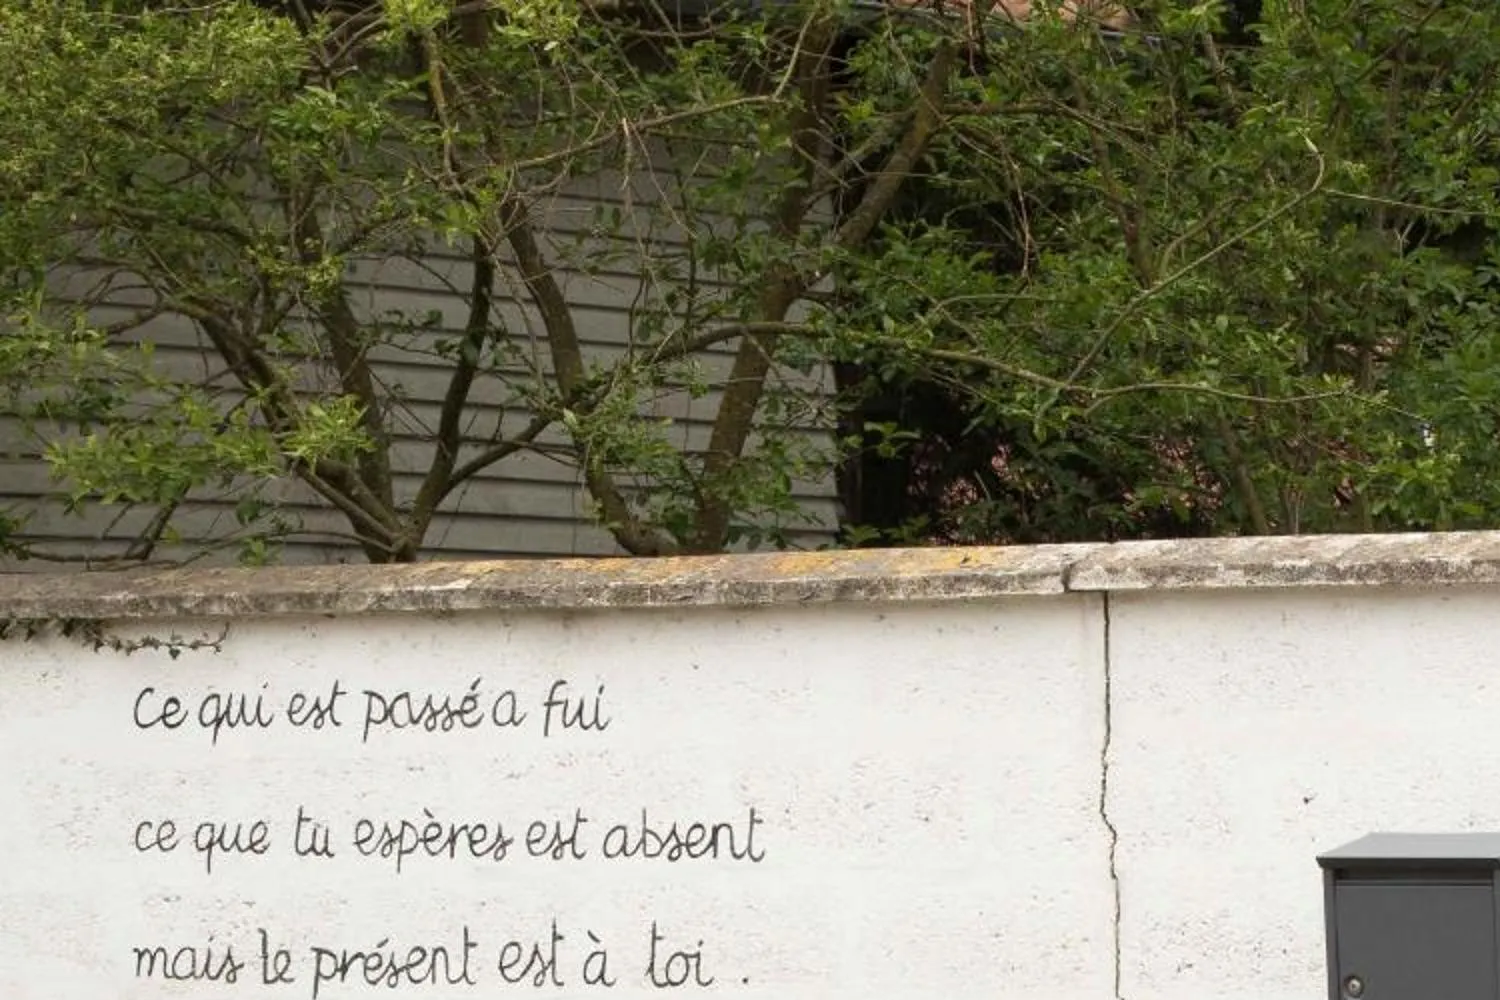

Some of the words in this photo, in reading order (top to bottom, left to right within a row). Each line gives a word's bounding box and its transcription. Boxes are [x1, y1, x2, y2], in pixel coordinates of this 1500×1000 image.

[133, 686, 189, 731] Ce
[197, 682, 274, 745] qui
[286, 679, 347, 731] est
[362, 677, 484, 743] passé
[491, 689, 527, 728] a
[542, 678, 611, 738] fui
[134, 817, 179, 853] ce
[192, 819, 272, 874] que
[293, 806, 336, 858] tu
[352, 808, 512, 874] espères
[525, 808, 588, 861] est
[602, 807, 766, 863] absent
[132, 935, 245, 985] mais
[257, 927, 295, 986] le
[310, 926, 479, 1000] présent
[497, 918, 566, 988] est
[582, 929, 616, 988] à
